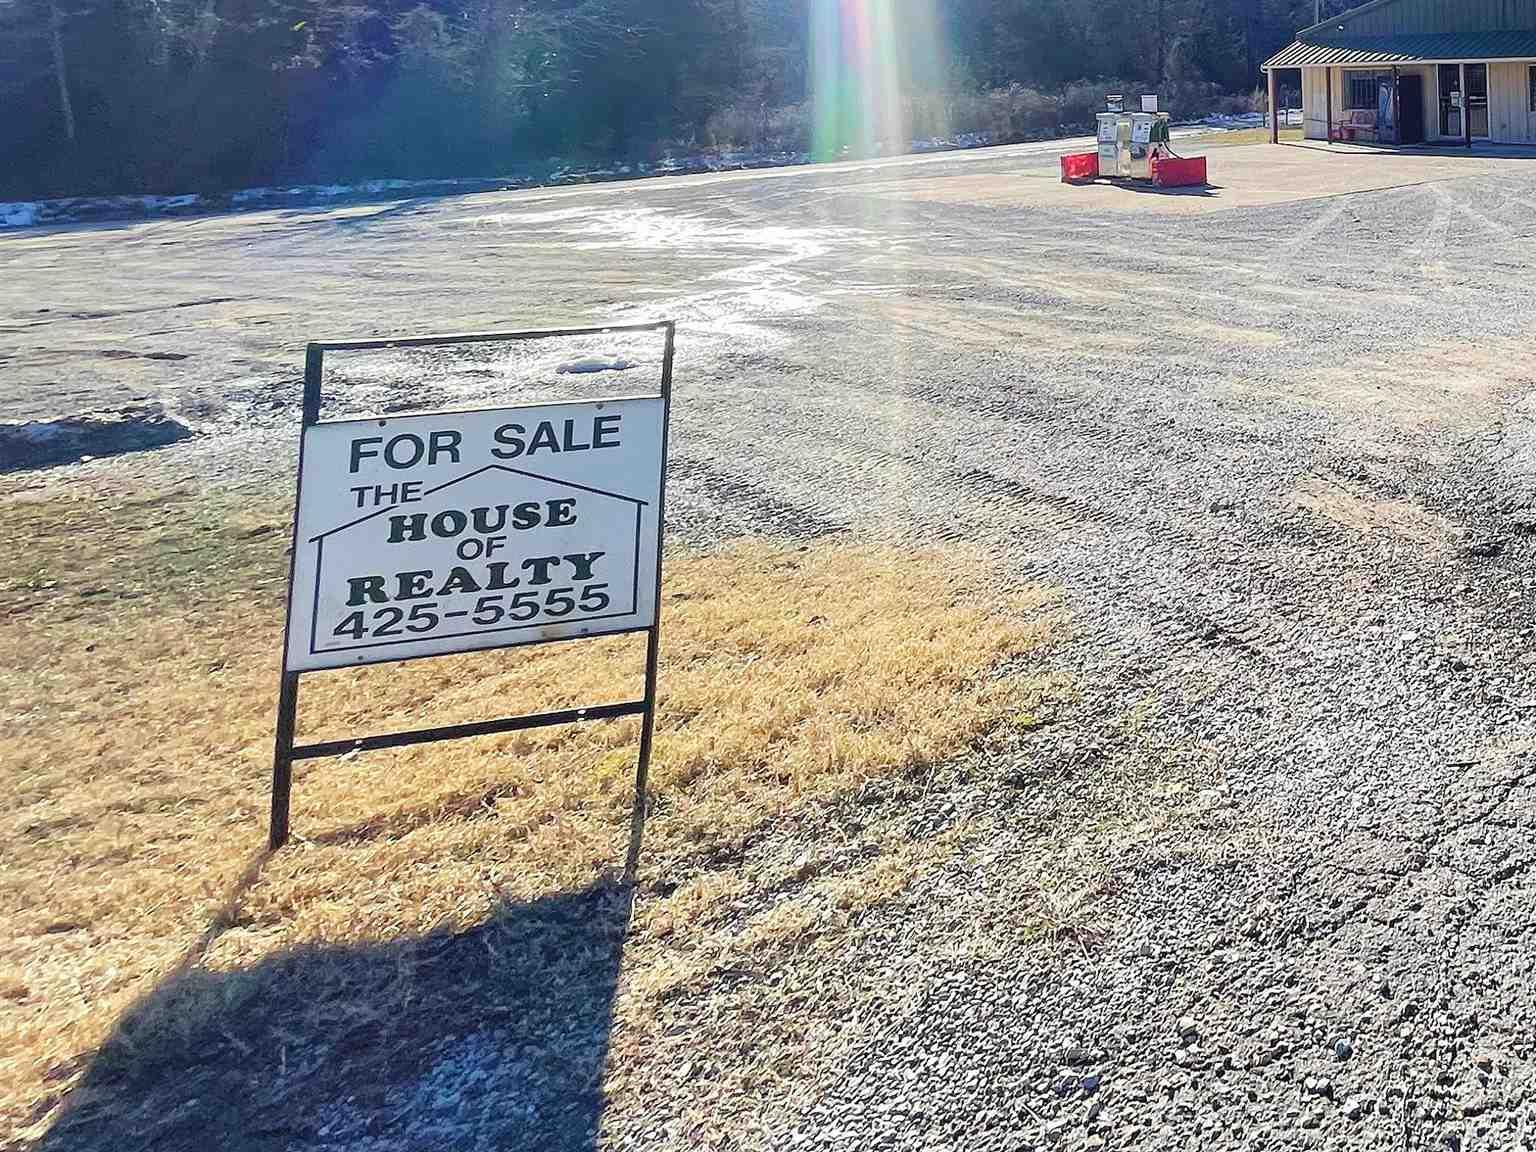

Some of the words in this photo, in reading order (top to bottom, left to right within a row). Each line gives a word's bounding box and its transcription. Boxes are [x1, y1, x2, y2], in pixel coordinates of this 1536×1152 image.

[349, 431, 462, 473] FOR
[490, 415, 622, 460] SALE
[350, 481, 423, 508] THE
[387, 498, 577, 543] HOUSE
[456, 536, 506, 560] OF
[346, 552, 605, 606] REALTY
[333, 584, 610, 640] 425-5555
